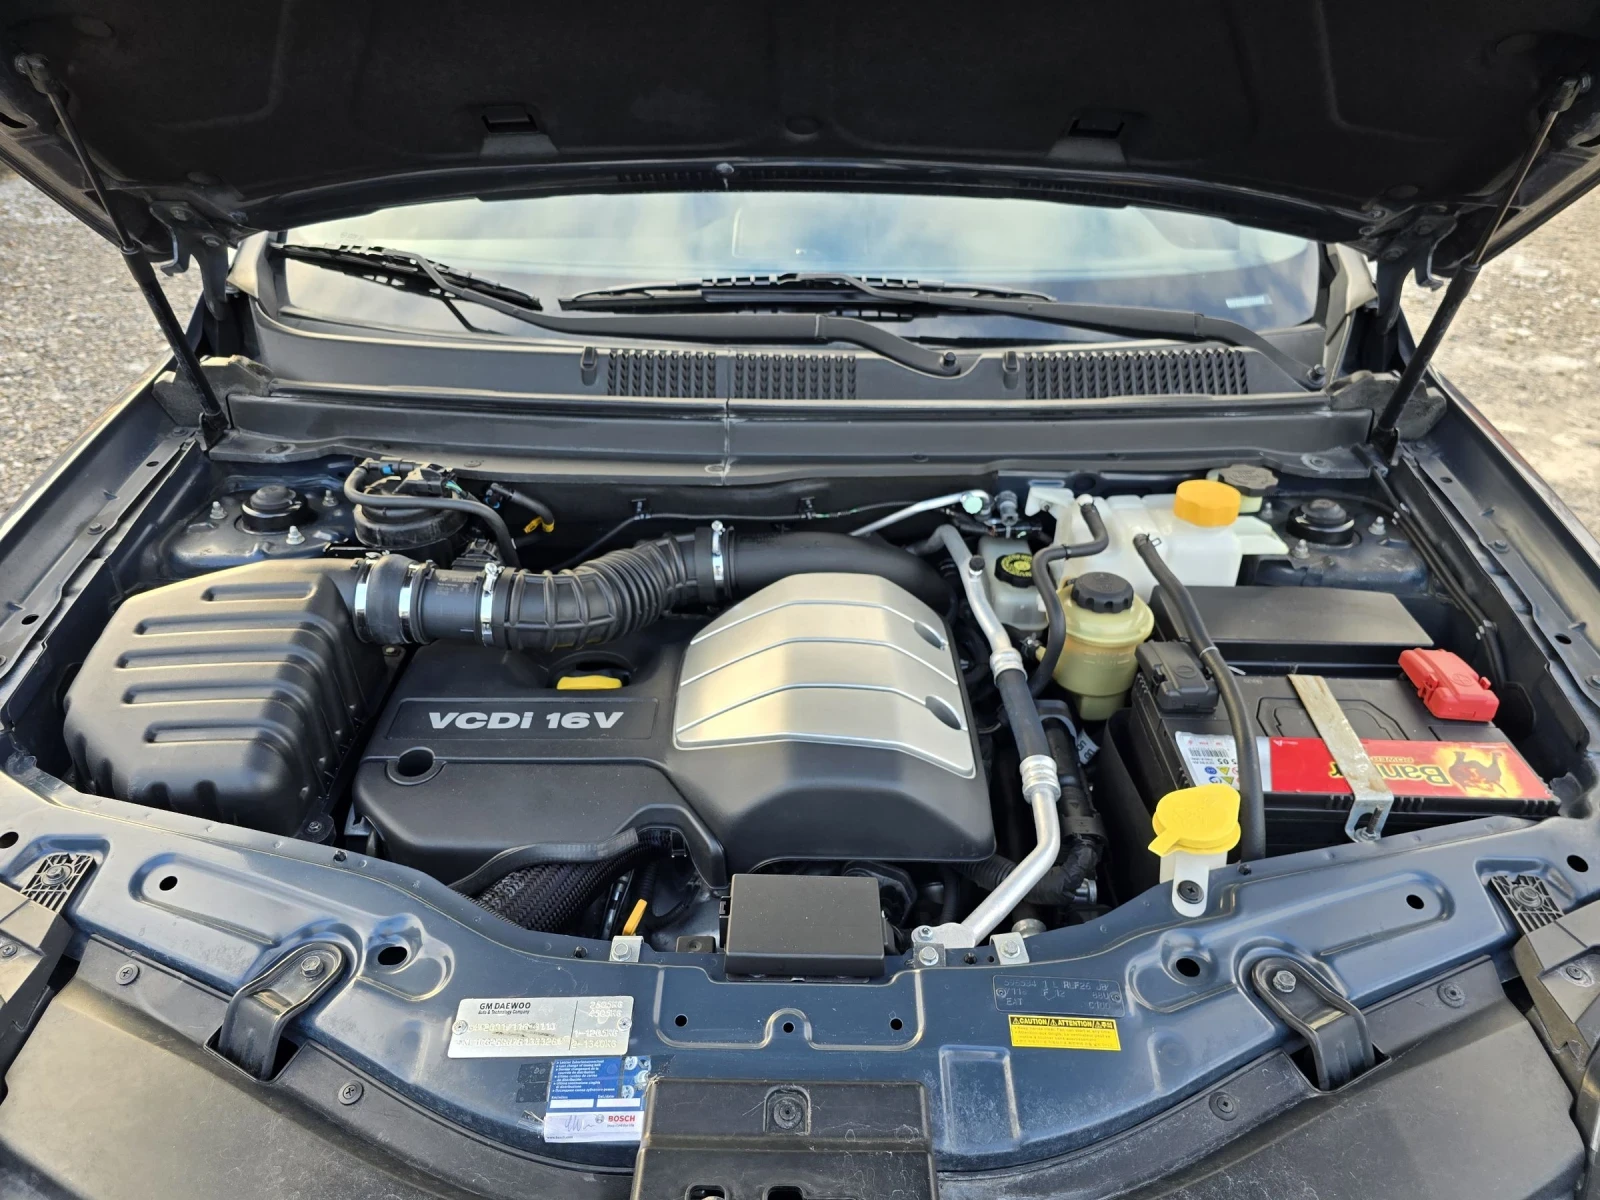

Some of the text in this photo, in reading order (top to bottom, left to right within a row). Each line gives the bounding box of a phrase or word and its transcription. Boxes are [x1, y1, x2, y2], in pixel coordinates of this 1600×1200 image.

[429, 711, 624, 729] VCDi 16V
[1328, 760, 1452, 786] Banr
[494, 1002, 531, 1010] DAEWOO
[1057, 1019, 1092, 1027] ATTENTION
